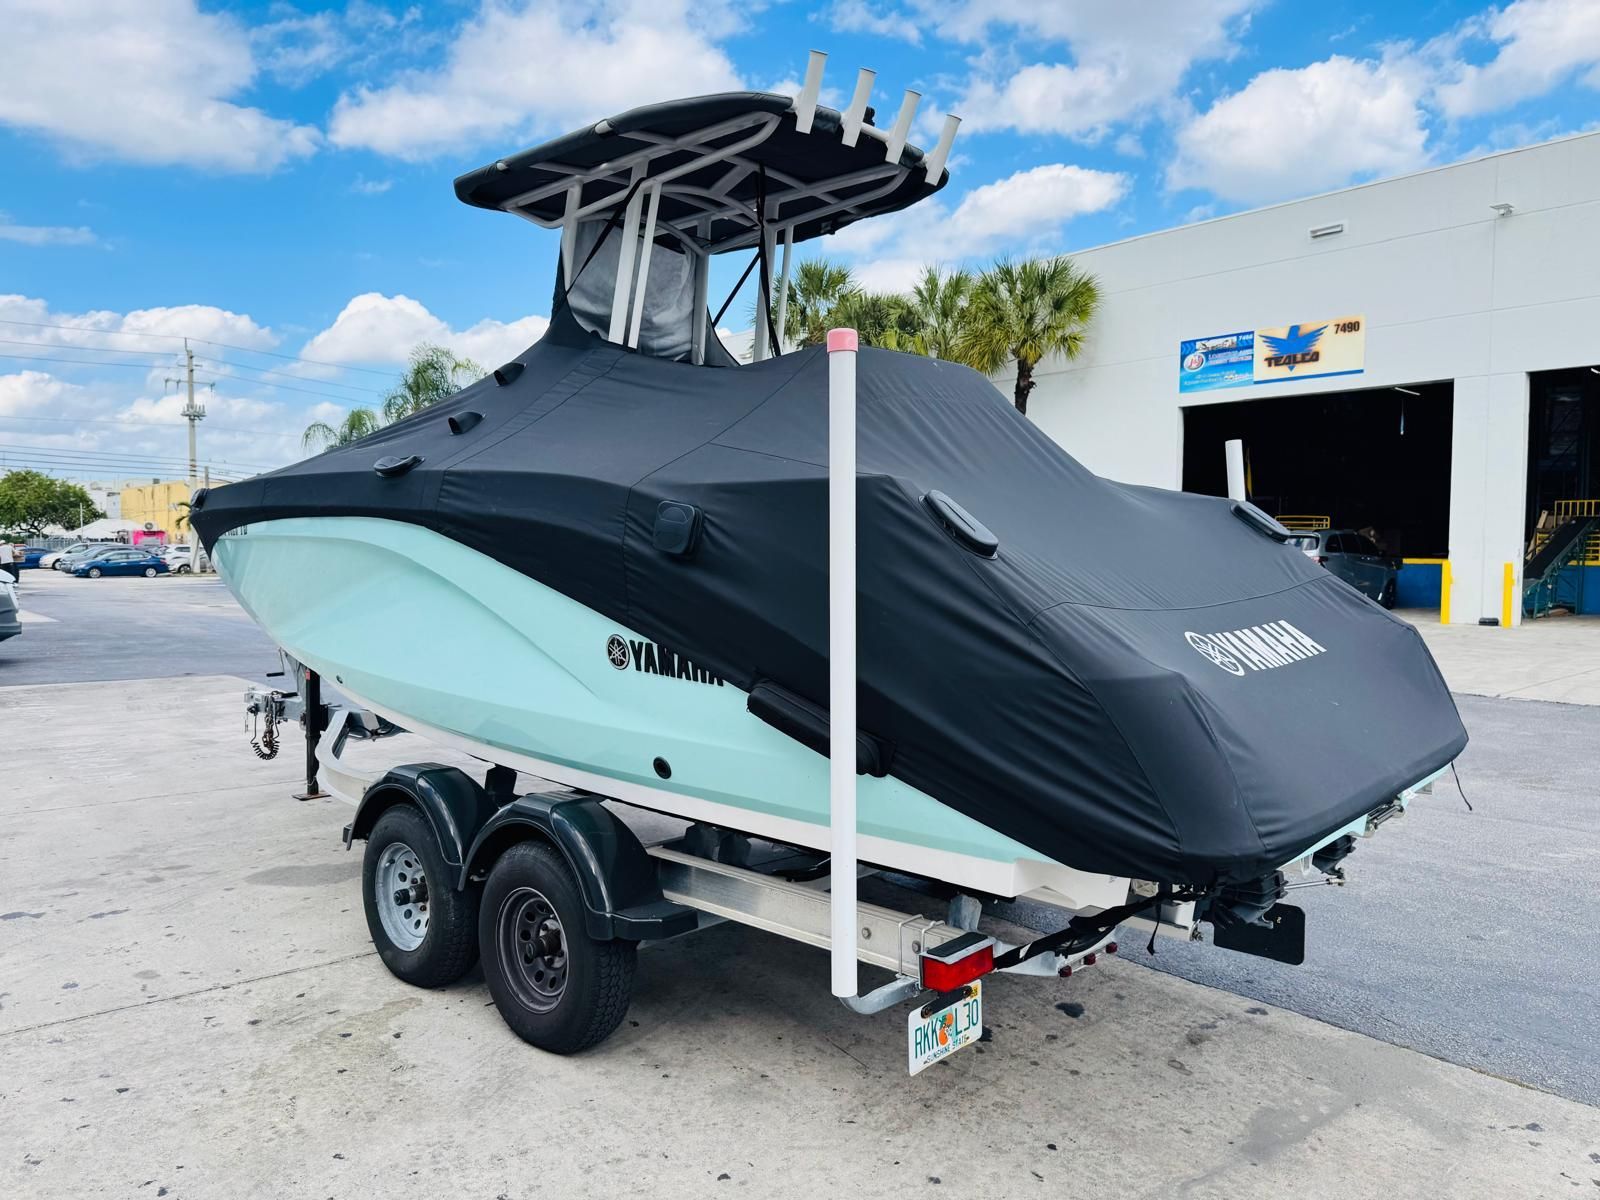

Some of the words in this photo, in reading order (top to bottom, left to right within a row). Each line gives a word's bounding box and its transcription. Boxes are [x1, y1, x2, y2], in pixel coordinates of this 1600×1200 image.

[1334, 321, 1360, 334] 7490
[1206, 619, 1328, 671] YAMAHA
[915, 1017, 939, 1059] RKK
[954, 998, 979, 1036] L30
